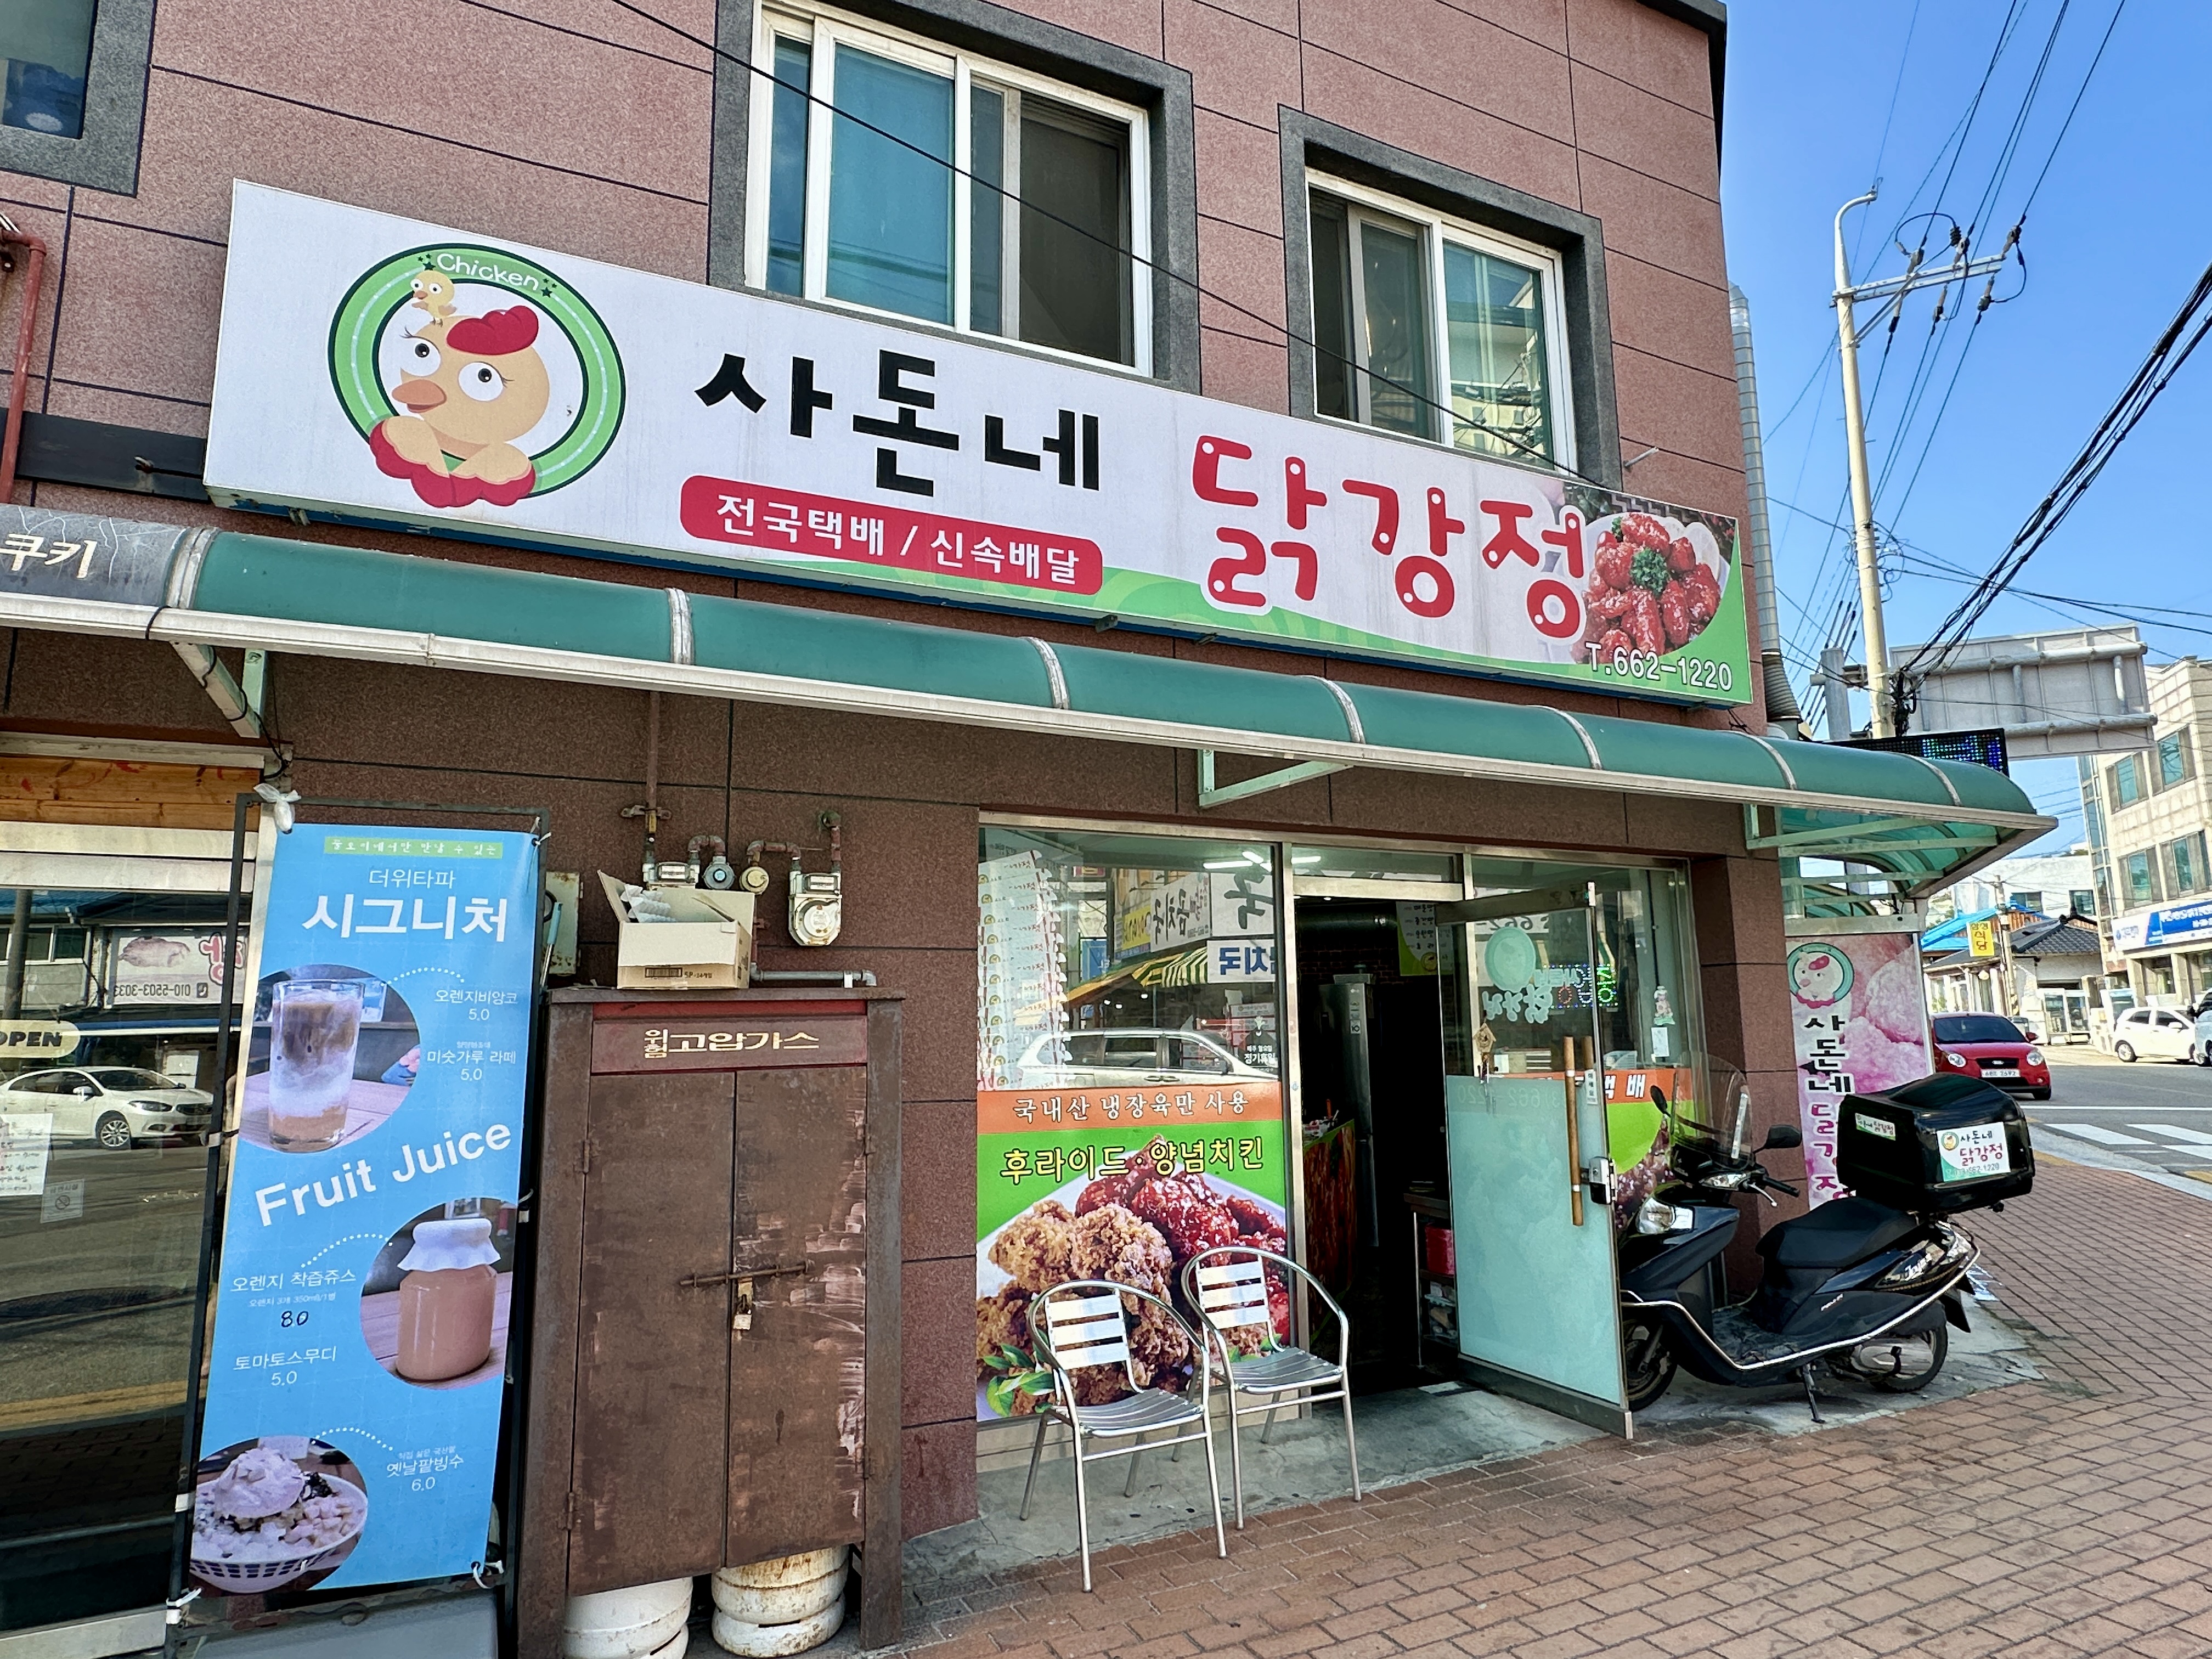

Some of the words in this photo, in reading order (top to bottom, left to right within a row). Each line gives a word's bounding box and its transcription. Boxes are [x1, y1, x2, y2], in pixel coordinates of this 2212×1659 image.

[437, 252, 541, 292] Chicken
[694, 349, 1100, 498] 사돈네
[716, 493, 884, 557] 전국택배
[930, 529, 1080, 586] 신속배달
[1192, 434, 1587, 640] 닭강정
[1584, 642, 1734, 692] T.662-1220
[454, 844, 464, 855] 수
[369, 868, 457, 889] 더위타파
[302, 893, 507, 943] 시그니처
[433, 989, 518, 1005] 오렌지비앙코
[468, 1008, 490, 1022] 5.0
[668, 1031, 820, 1052] 고압가스
[426, 1049, 485, 1065] 미숫가루
[489, 1050, 516, 1065] 라떼
[1804, 1015, 1851, 1093] 사돈네
[460, 1068, 483, 1082] 5.0
[1012, 1096, 1091, 1124] 국내산
[1100, 1091, 1197, 1121] 냉장육만
[1204, 1088, 1249, 1115] 사용
[1960, 1130, 1993, 1144] 사돈네
[1959, 1143, 2003, 1166] 닭강정
[254, 1158, 377, 1227] Fruit
[392, 1122, 512, 1184] Juice
[229, 1273, 284, 1292] 오렌지
[289, 1268, 357, 1288] 착즙쥬스
[233, 1346, 337, 1372] 토마토스무디
[270, 1370, 298, 1387] 5.0
[386, 1453, 465, 1479] 옛날팥빙수
[411, 1476, 436, 1492] 6.0
